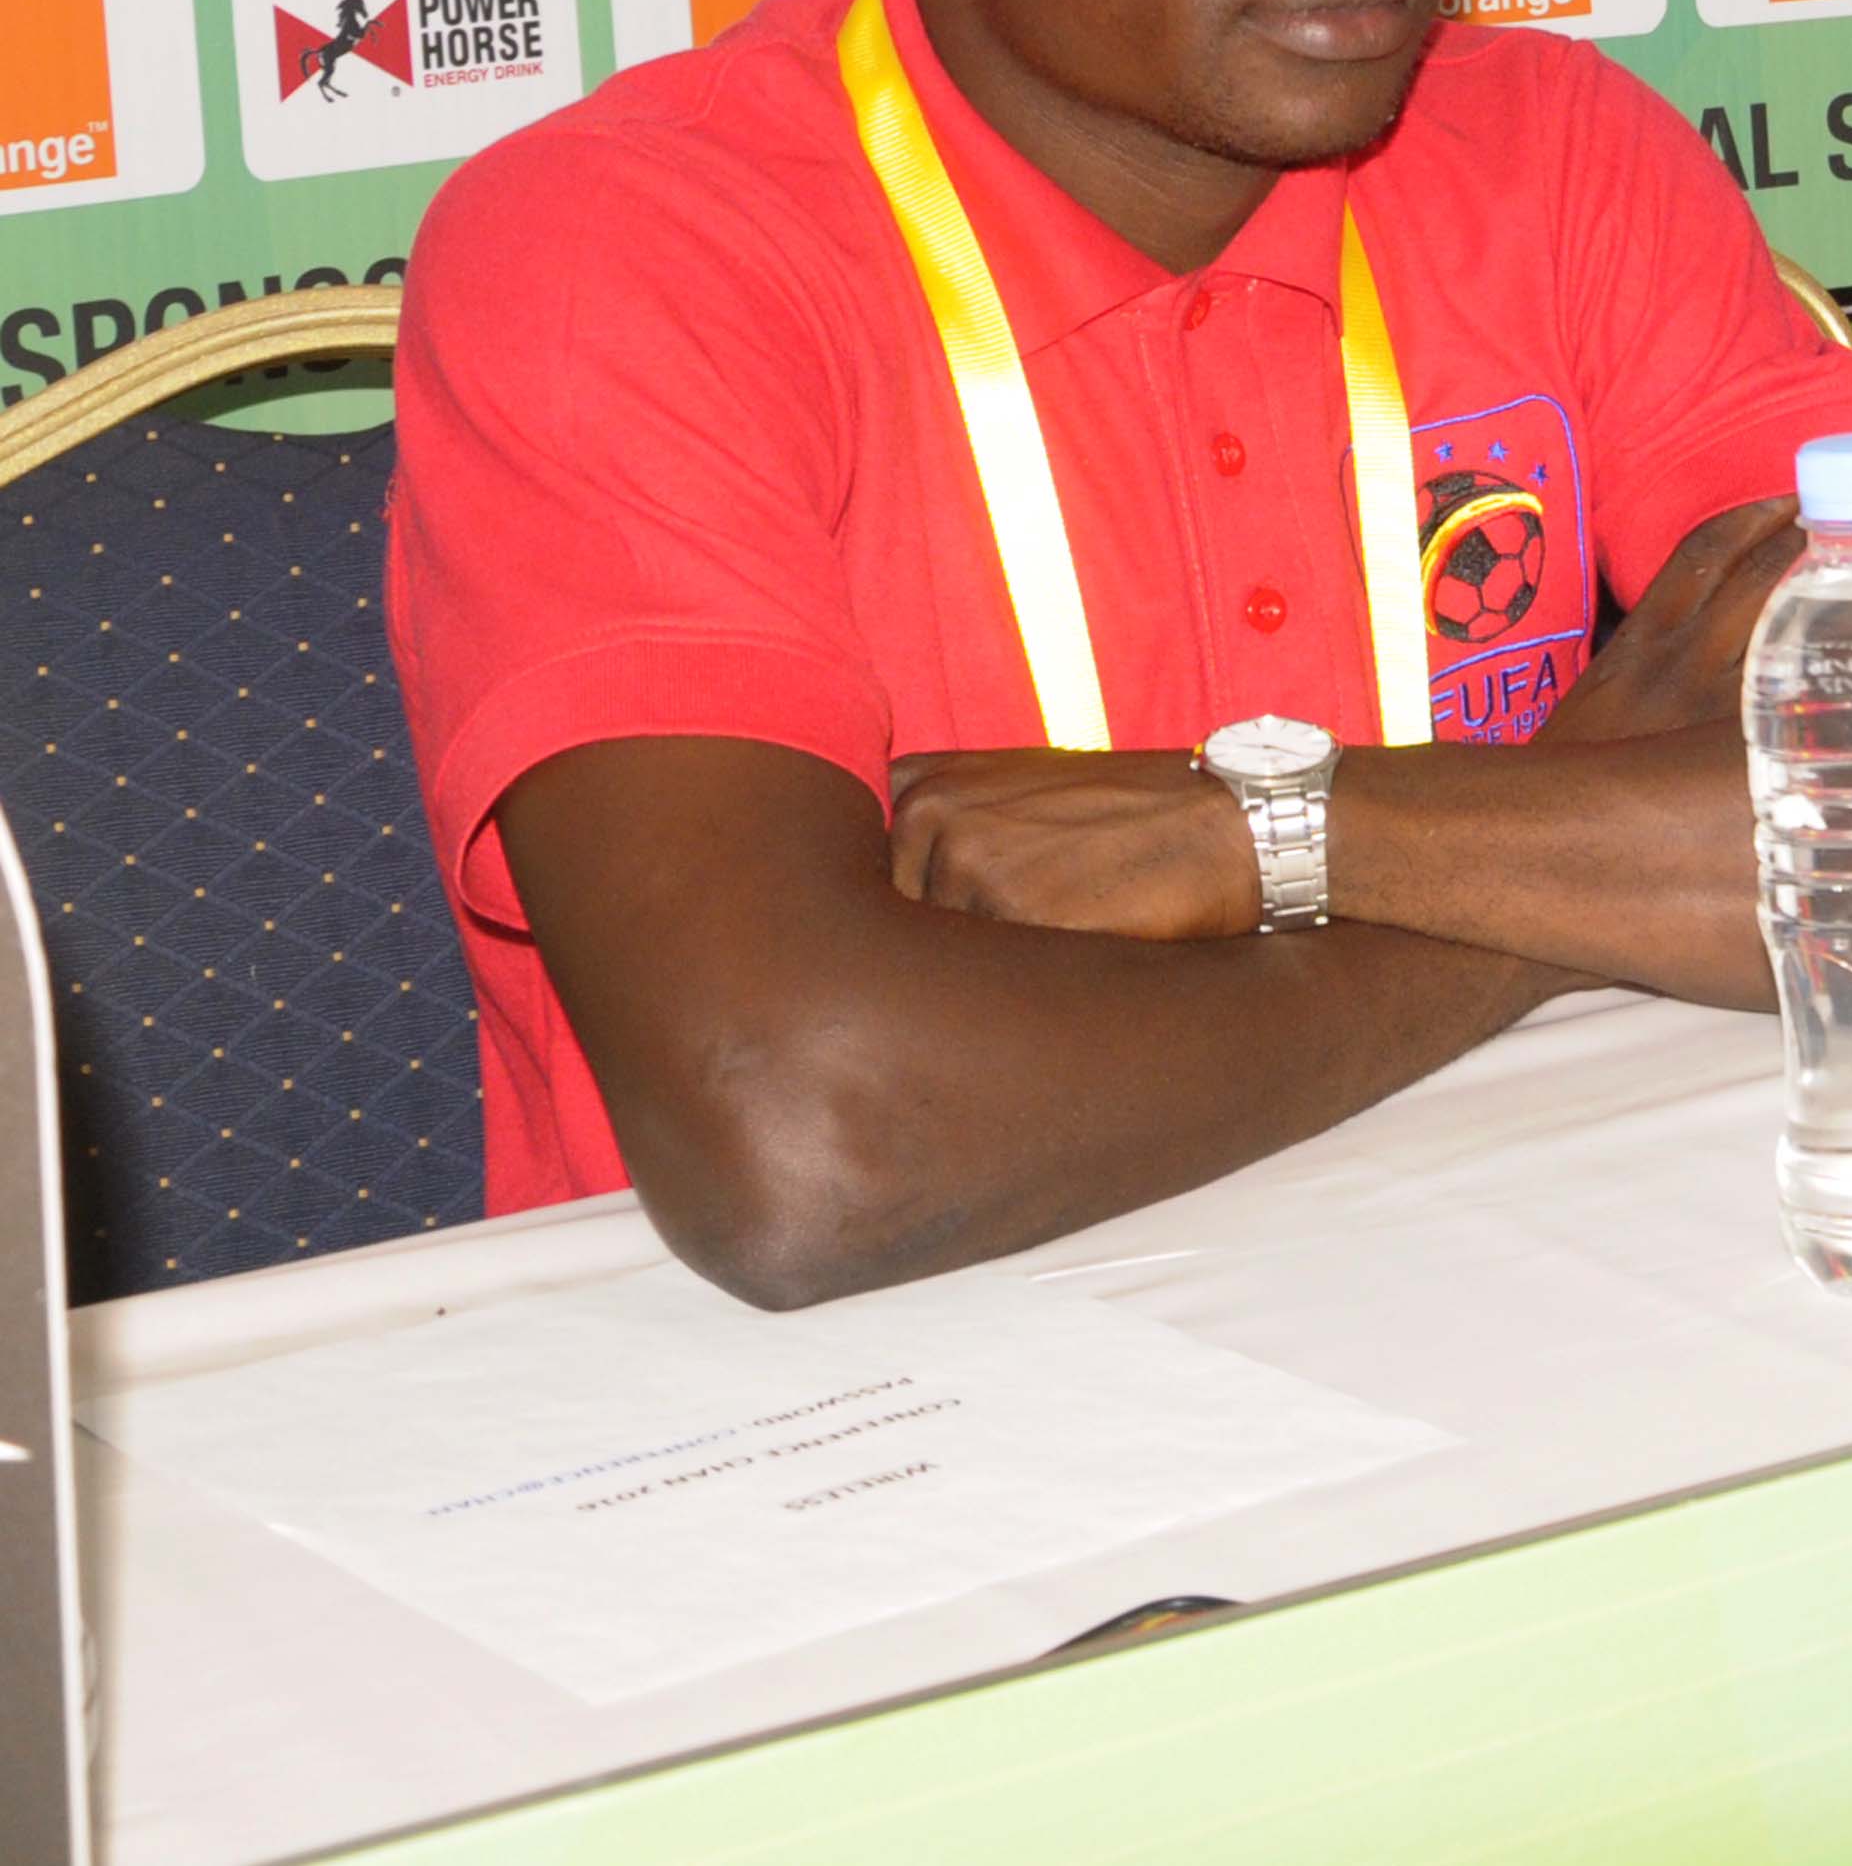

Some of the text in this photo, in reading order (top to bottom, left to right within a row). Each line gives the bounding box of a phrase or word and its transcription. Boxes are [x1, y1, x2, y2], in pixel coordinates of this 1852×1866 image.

[422, 21, 542, 69] HORSE
[425, 64, 541, 87] ENERGY DRINK
[765, 1396, 963, 1458] CONFERENCE
[662, 1455, 755, 1488] CHAN
[783, 1460, 937, 1513] WIRELESS
